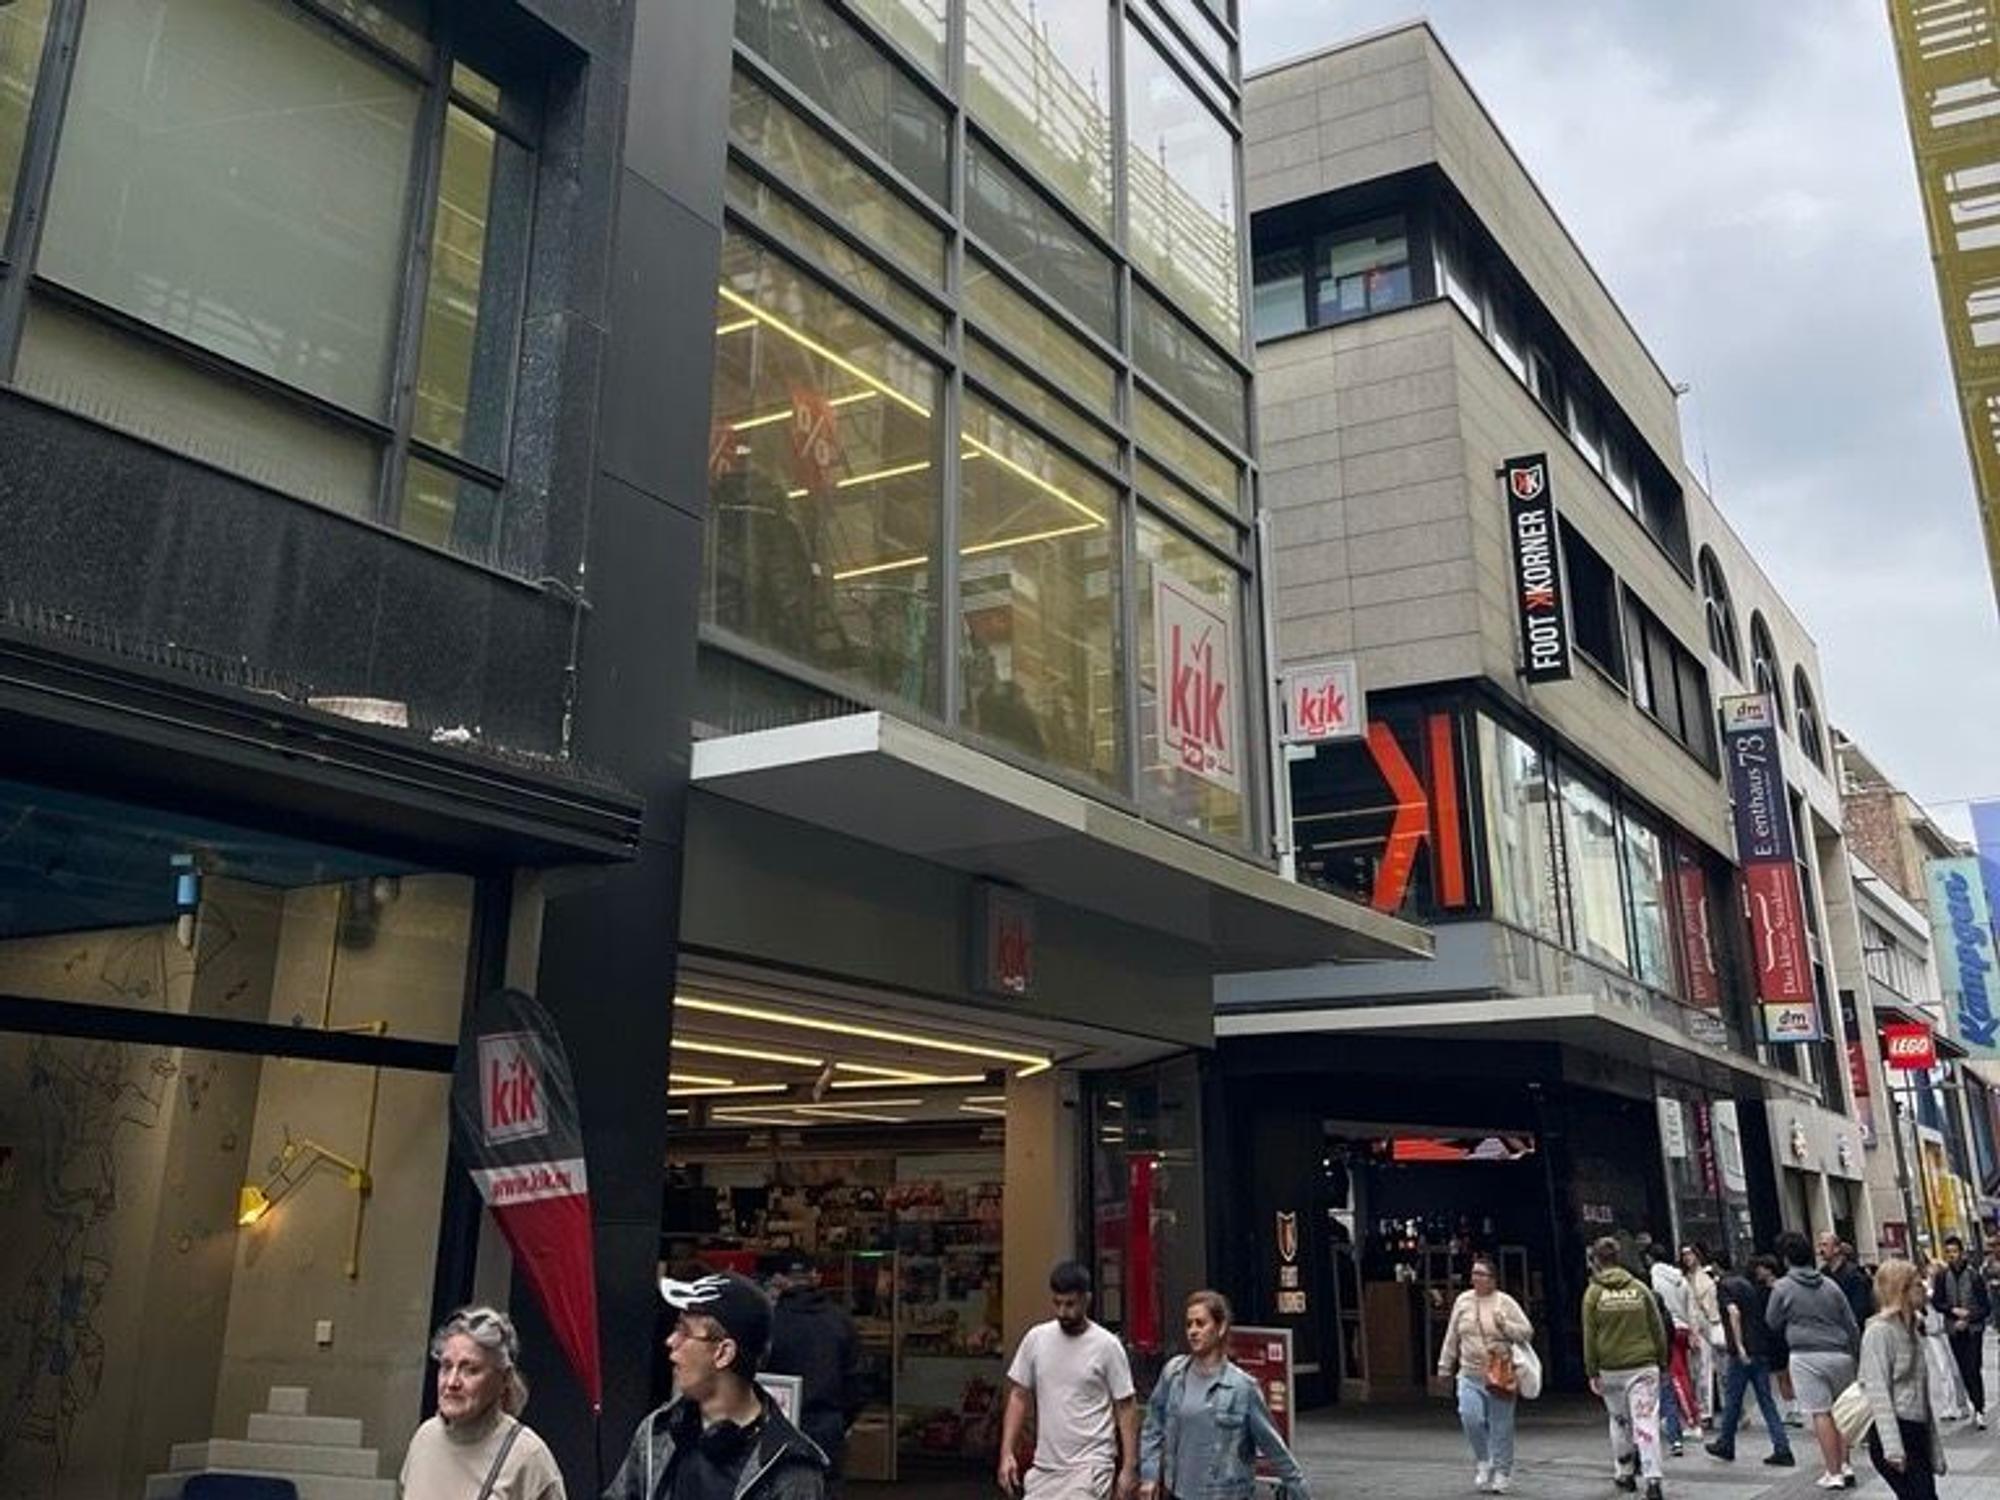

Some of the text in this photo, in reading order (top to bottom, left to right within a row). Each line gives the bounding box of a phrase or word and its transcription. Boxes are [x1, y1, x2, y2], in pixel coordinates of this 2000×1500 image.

[1528, 616, 1561, 669] FOOT
[1737, 701, 1761, 716] dm
[1736, 735, 1767, 768] 73
[1747, 768, 1772, 855] Eenthaus
[1945, 871, 2000, 1047] Kämpgen
[1779, 1010, 1806, 1024] dm
[1890, 1036, 1928, 1054] LEGO
